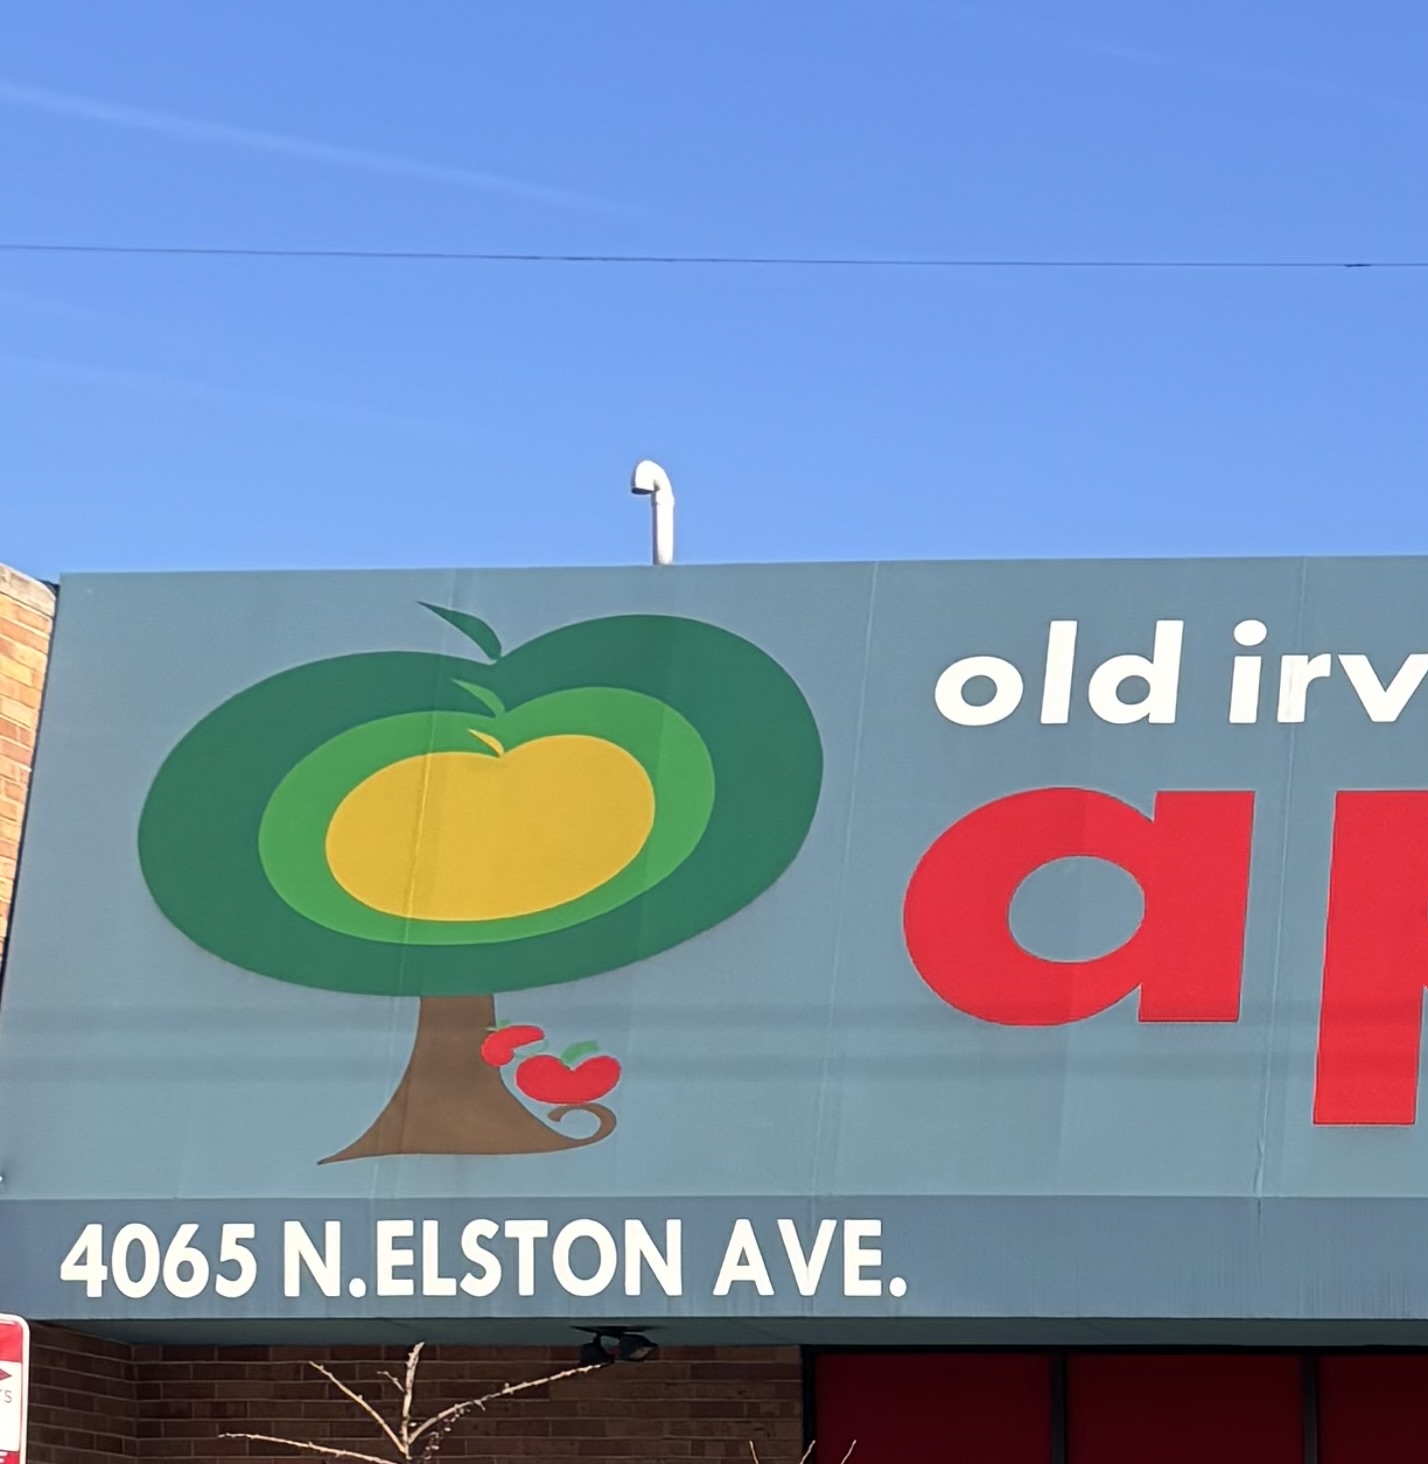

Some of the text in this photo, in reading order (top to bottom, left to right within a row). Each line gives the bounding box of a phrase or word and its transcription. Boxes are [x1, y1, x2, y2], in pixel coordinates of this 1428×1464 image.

[935, 620, 1184, 725] old
[59, 1222, 259, 1299] 4065
[713, 1218, 908, 1299] AVE.
